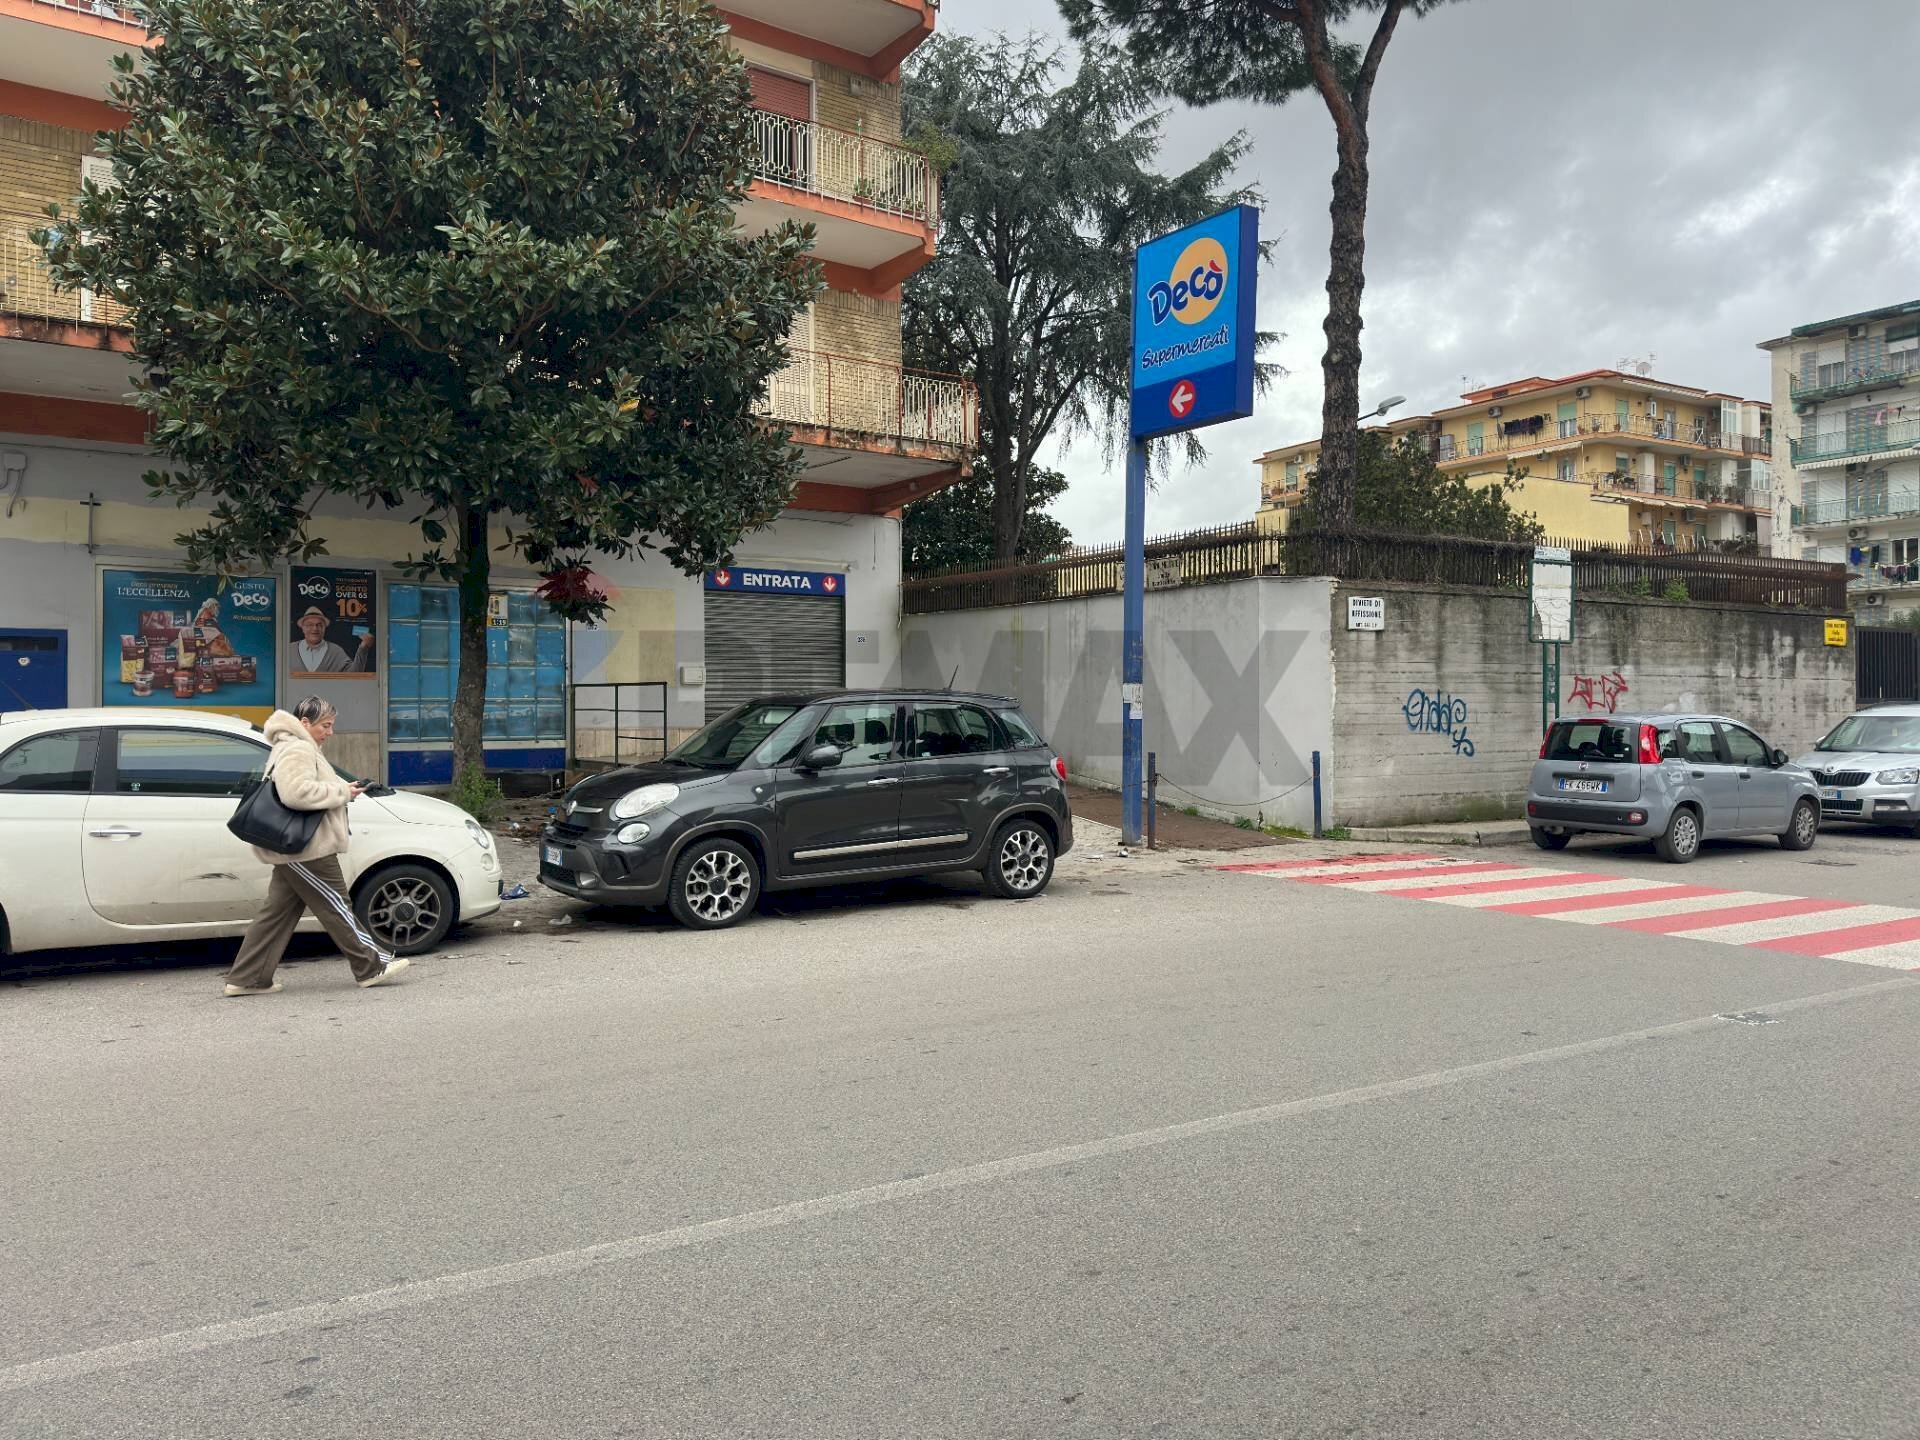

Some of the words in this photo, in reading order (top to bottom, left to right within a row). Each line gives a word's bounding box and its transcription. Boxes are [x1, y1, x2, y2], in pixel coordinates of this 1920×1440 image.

[1148, 259, 1223, 325] Decò
[1142, 323, 1229, 369] Supermercati
[743, 573, 812, 589] ENTRATA
[118, 587, 191, 598] L'ECCELLENZA
[336, 599, 368, 617] 10%
[1351, 610, 1382, 618] AFFISSIONE
